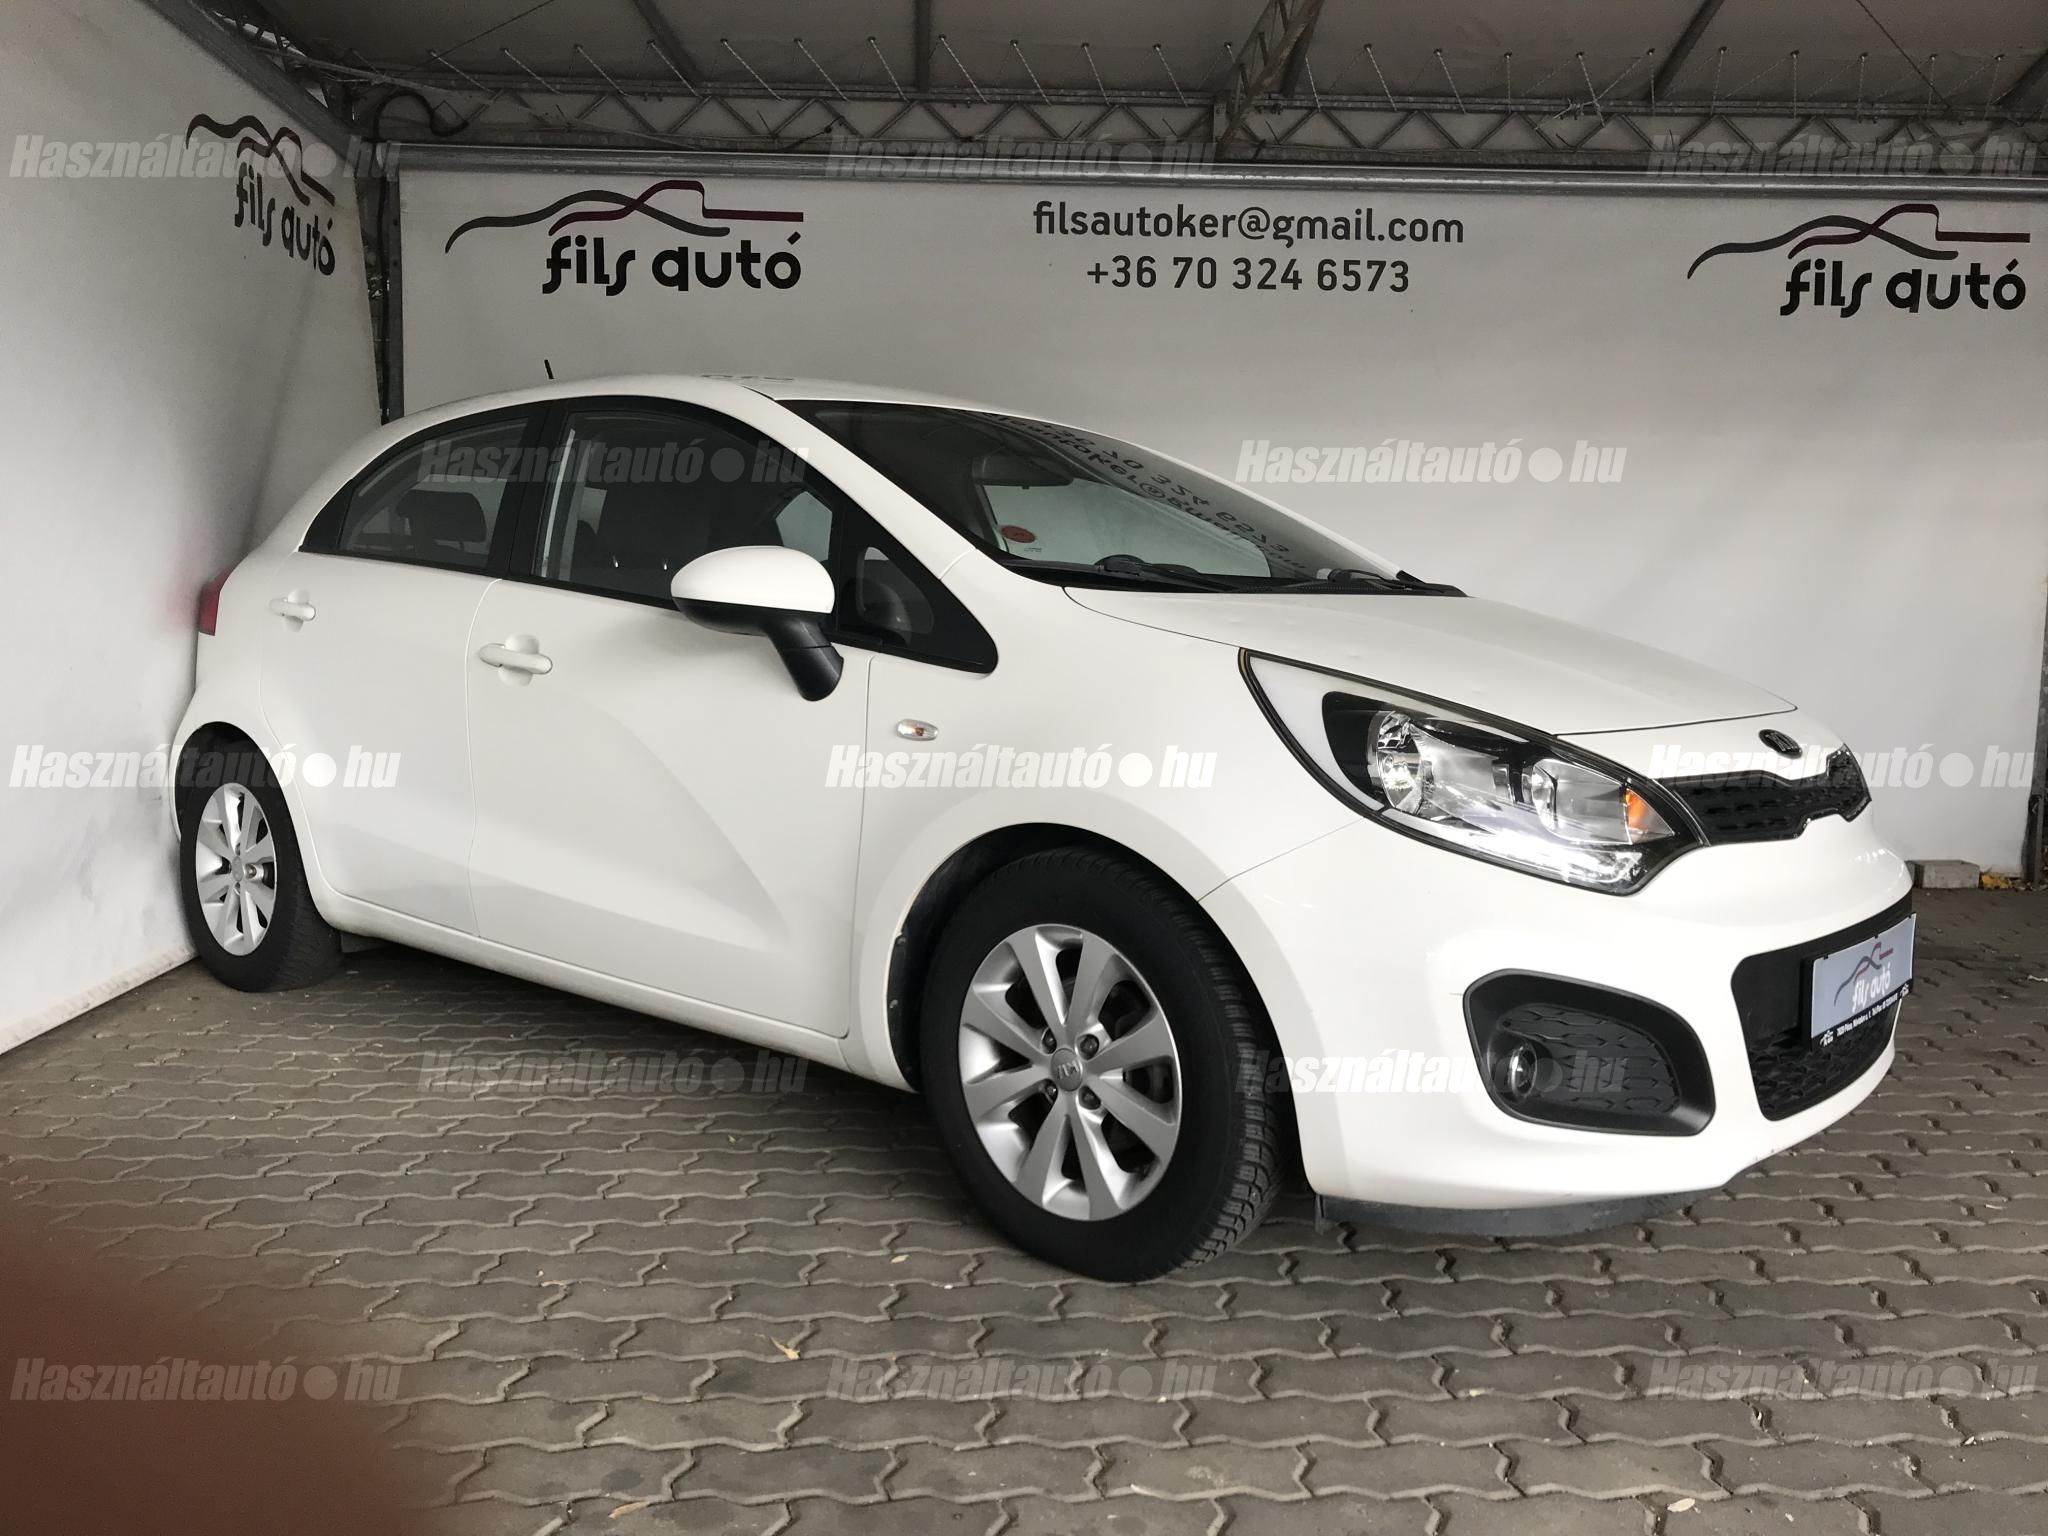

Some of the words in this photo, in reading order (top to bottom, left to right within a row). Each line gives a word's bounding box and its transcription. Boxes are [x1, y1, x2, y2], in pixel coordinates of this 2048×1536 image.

[234, 161, 276, 246] fils
[281, 204, 336, 276] autó
[1034, 200, 1465, 248] filsautoker@gmail.com
[542, 235, 636, 296] fils
[652, 231, 802, 291] autó
[1087, 256, 1157, 288] +36
[1171, 257, 1218, 290] 70
[1232, 258, 1303, 291] 324
[1316, 259, 1410, 292] 6573
[1779, 258, 1872, 318] fils
[1885, 258, 2026, 313] autó
